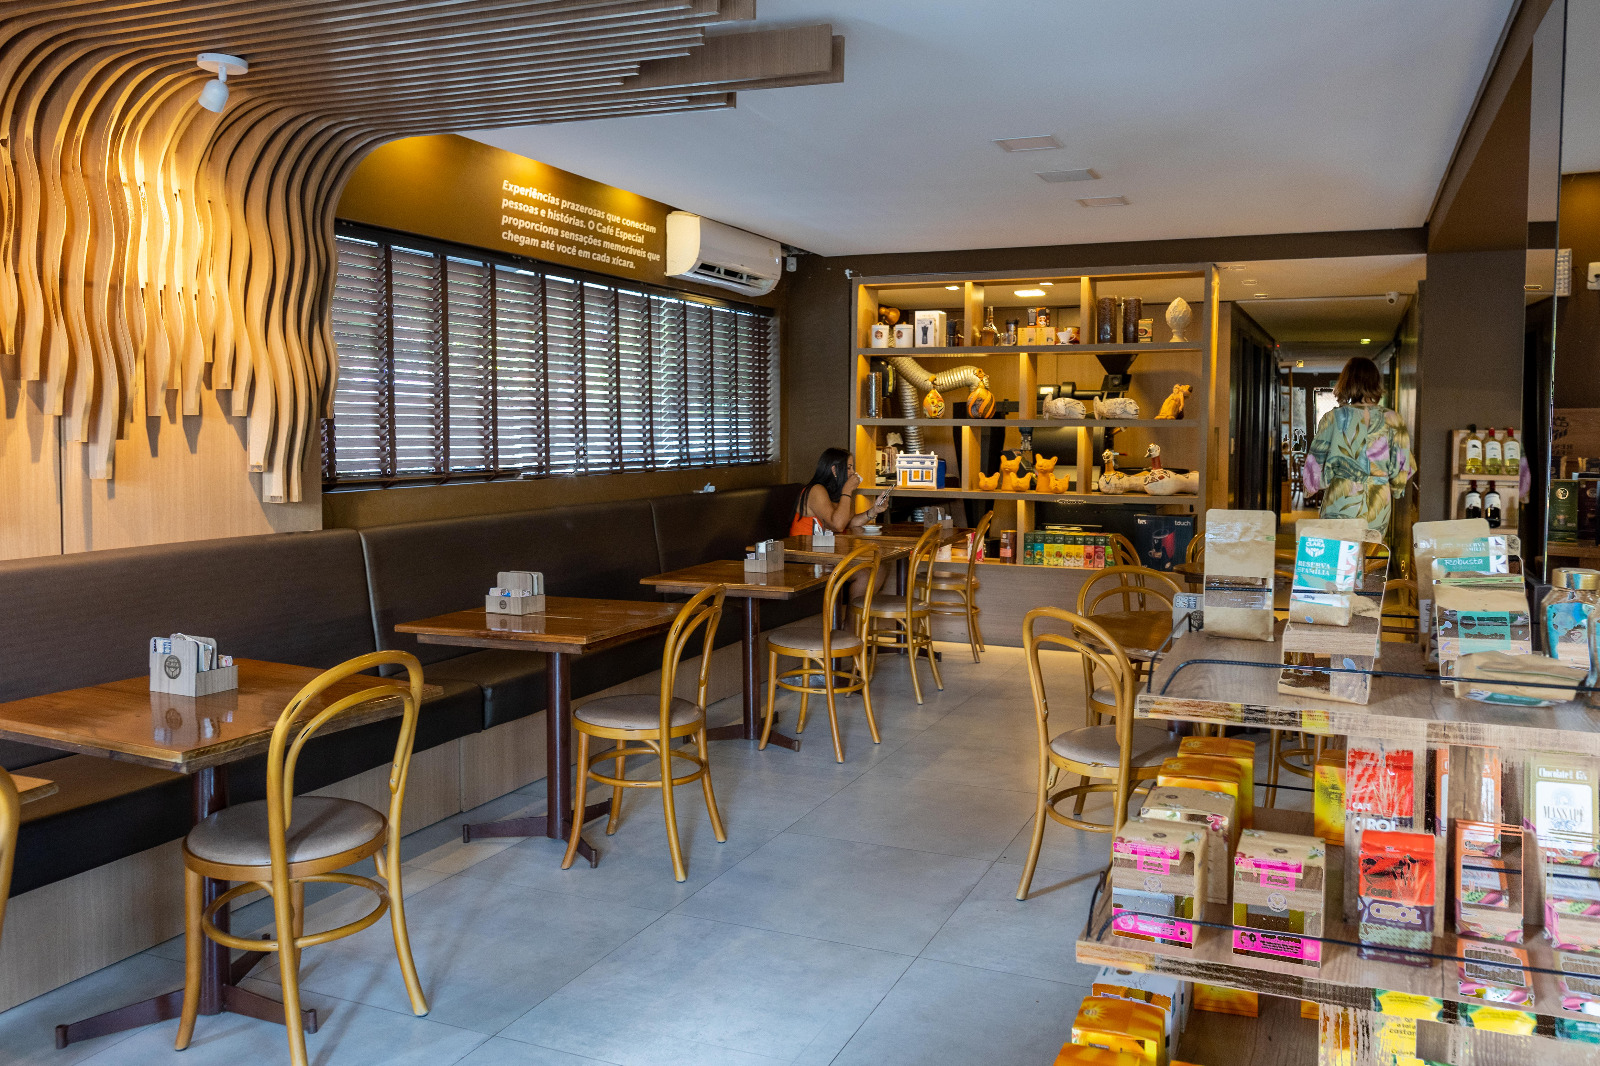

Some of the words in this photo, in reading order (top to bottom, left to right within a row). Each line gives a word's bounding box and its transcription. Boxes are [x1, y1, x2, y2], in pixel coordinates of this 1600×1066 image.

[501, 198, 539, 216] pessoas
[540, 209, 546, 218] e
[547, 208, 586, 229] histórias.
[587, 220, 595, 231] O
[597, 222, 614, 235] Café
[615, 227, 645, 244] Especial
[502, 179, 560, 206] Experiências
[560, 199, 605, 219] prazerosas
[606, 212, 621, 224] que
[621, 217, 657, 234] conectam
[501, 214, 559, 237] proporciona
[560, 229, 602, 247] sensações
[602, 240, 647, 259] memoráveis
[647, 251, 661, 262] que
[501, 230, 539, 248] chegam
[541, 240, 555, 251] até
[556, 242, 577, 256] você
[578, 249, 591, 260] em
[592, 250, 611, 264] cada
[611, 255, 636, 269] xícara.
[1444, 558, 1484, 566] Robusta
